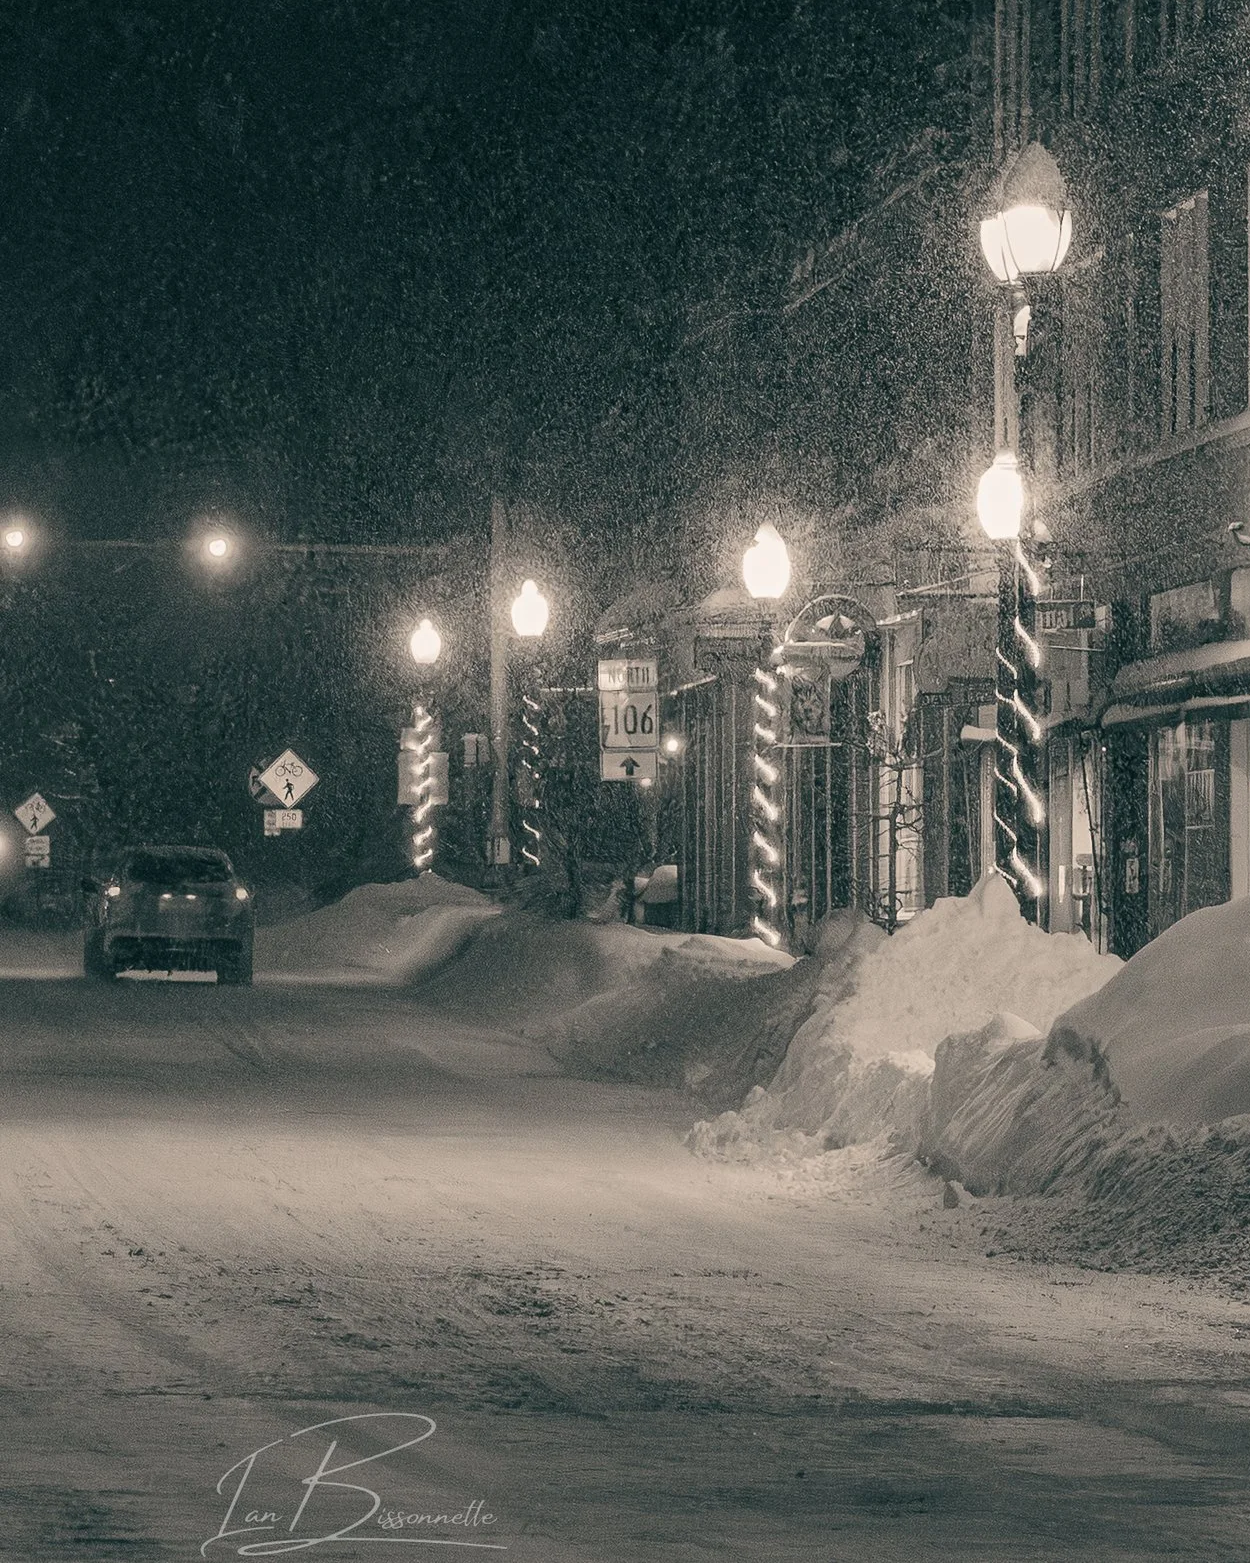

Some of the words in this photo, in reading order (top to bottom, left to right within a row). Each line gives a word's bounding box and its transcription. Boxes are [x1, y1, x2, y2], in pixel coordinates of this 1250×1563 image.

[608, 666, 650, 684] NORTH
[614, 704, 654, 736] 106
[281, 812, 298, 822] 250
